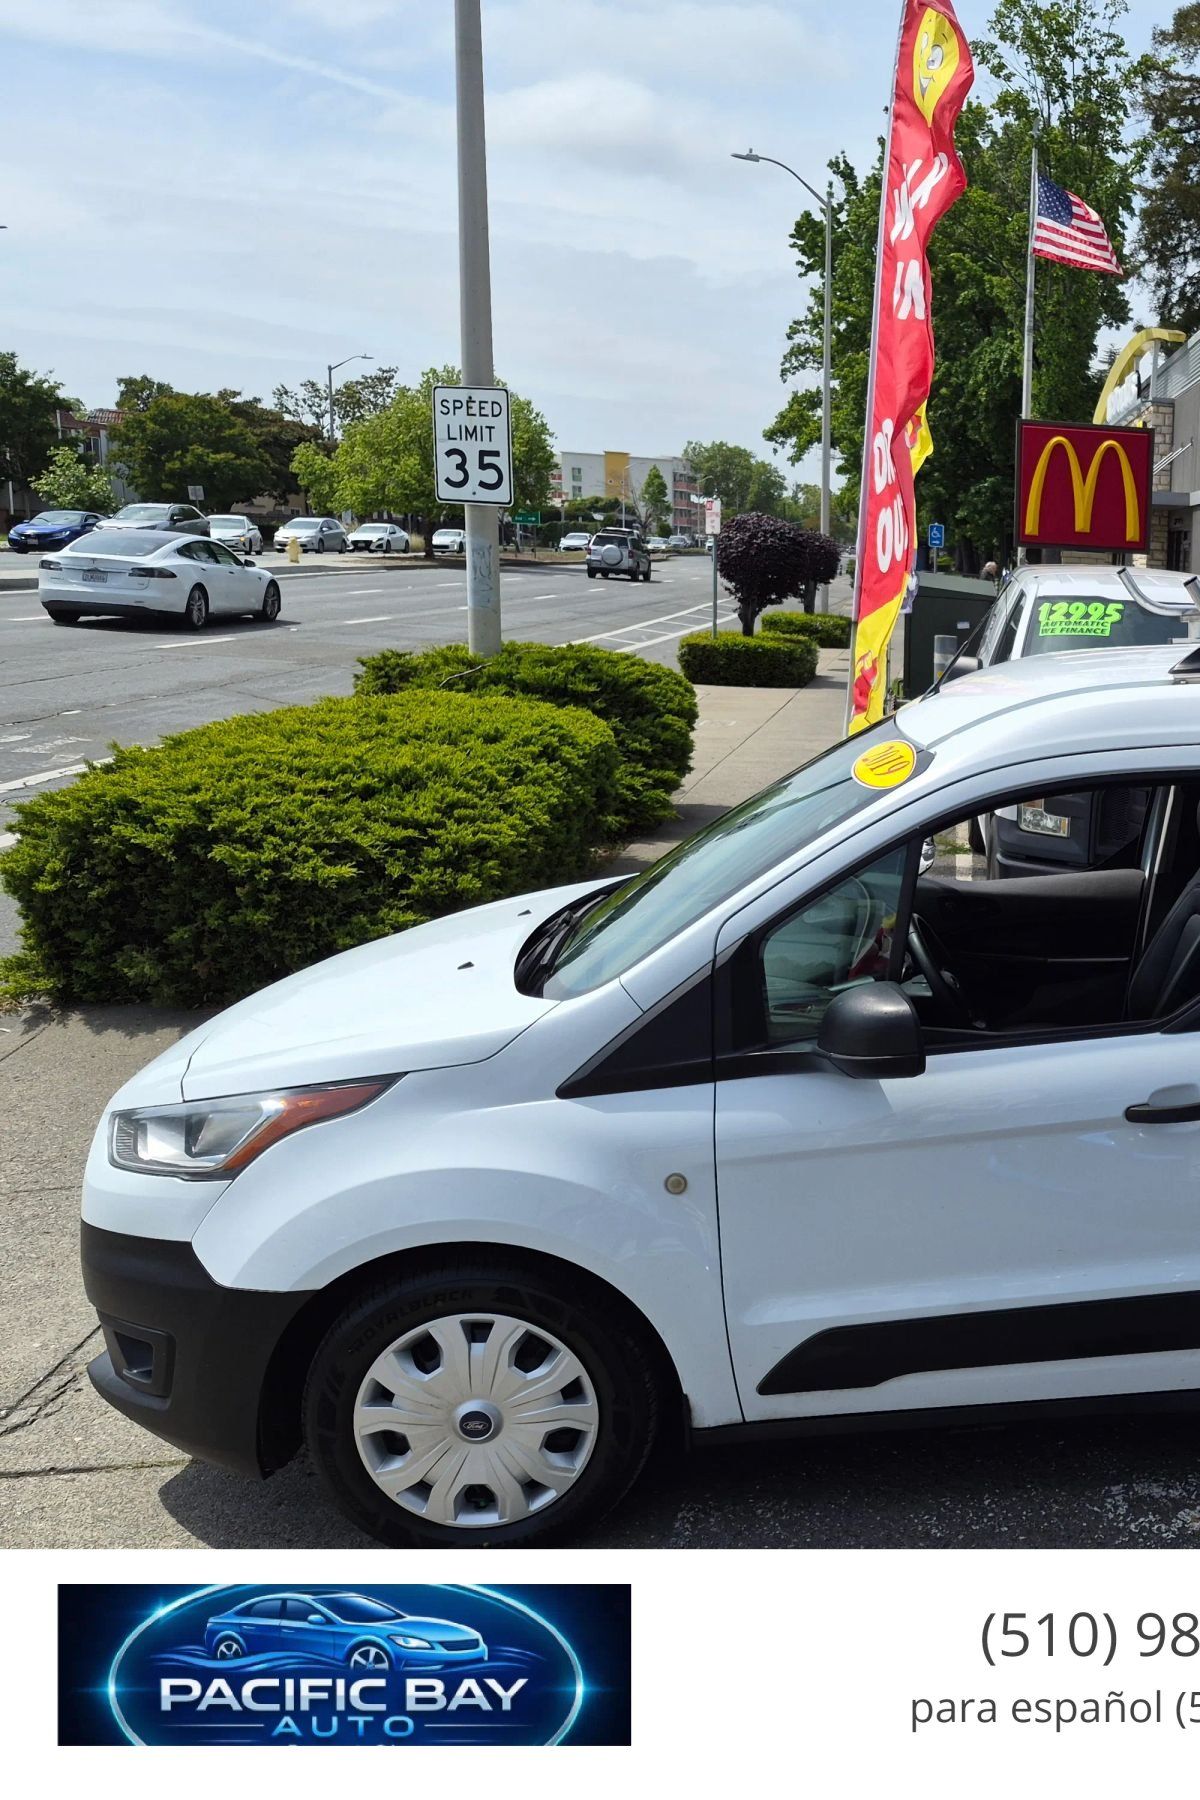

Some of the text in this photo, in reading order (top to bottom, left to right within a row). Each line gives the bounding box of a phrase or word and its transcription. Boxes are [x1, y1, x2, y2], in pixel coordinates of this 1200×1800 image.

[440, 398, 503, 418] SPEED
[447, 424, 496, 442] LIMIT
[444, 448, 504, 491] 35
[876, 493, 909, 573] OU
[1038, 602, 1124, 623] 12995
[1041, 627, 1108, 635] WE FINANCE
[1043, 620, 1109, 628] AUTOMATIC
[862, 745, 911, 776] 2019
